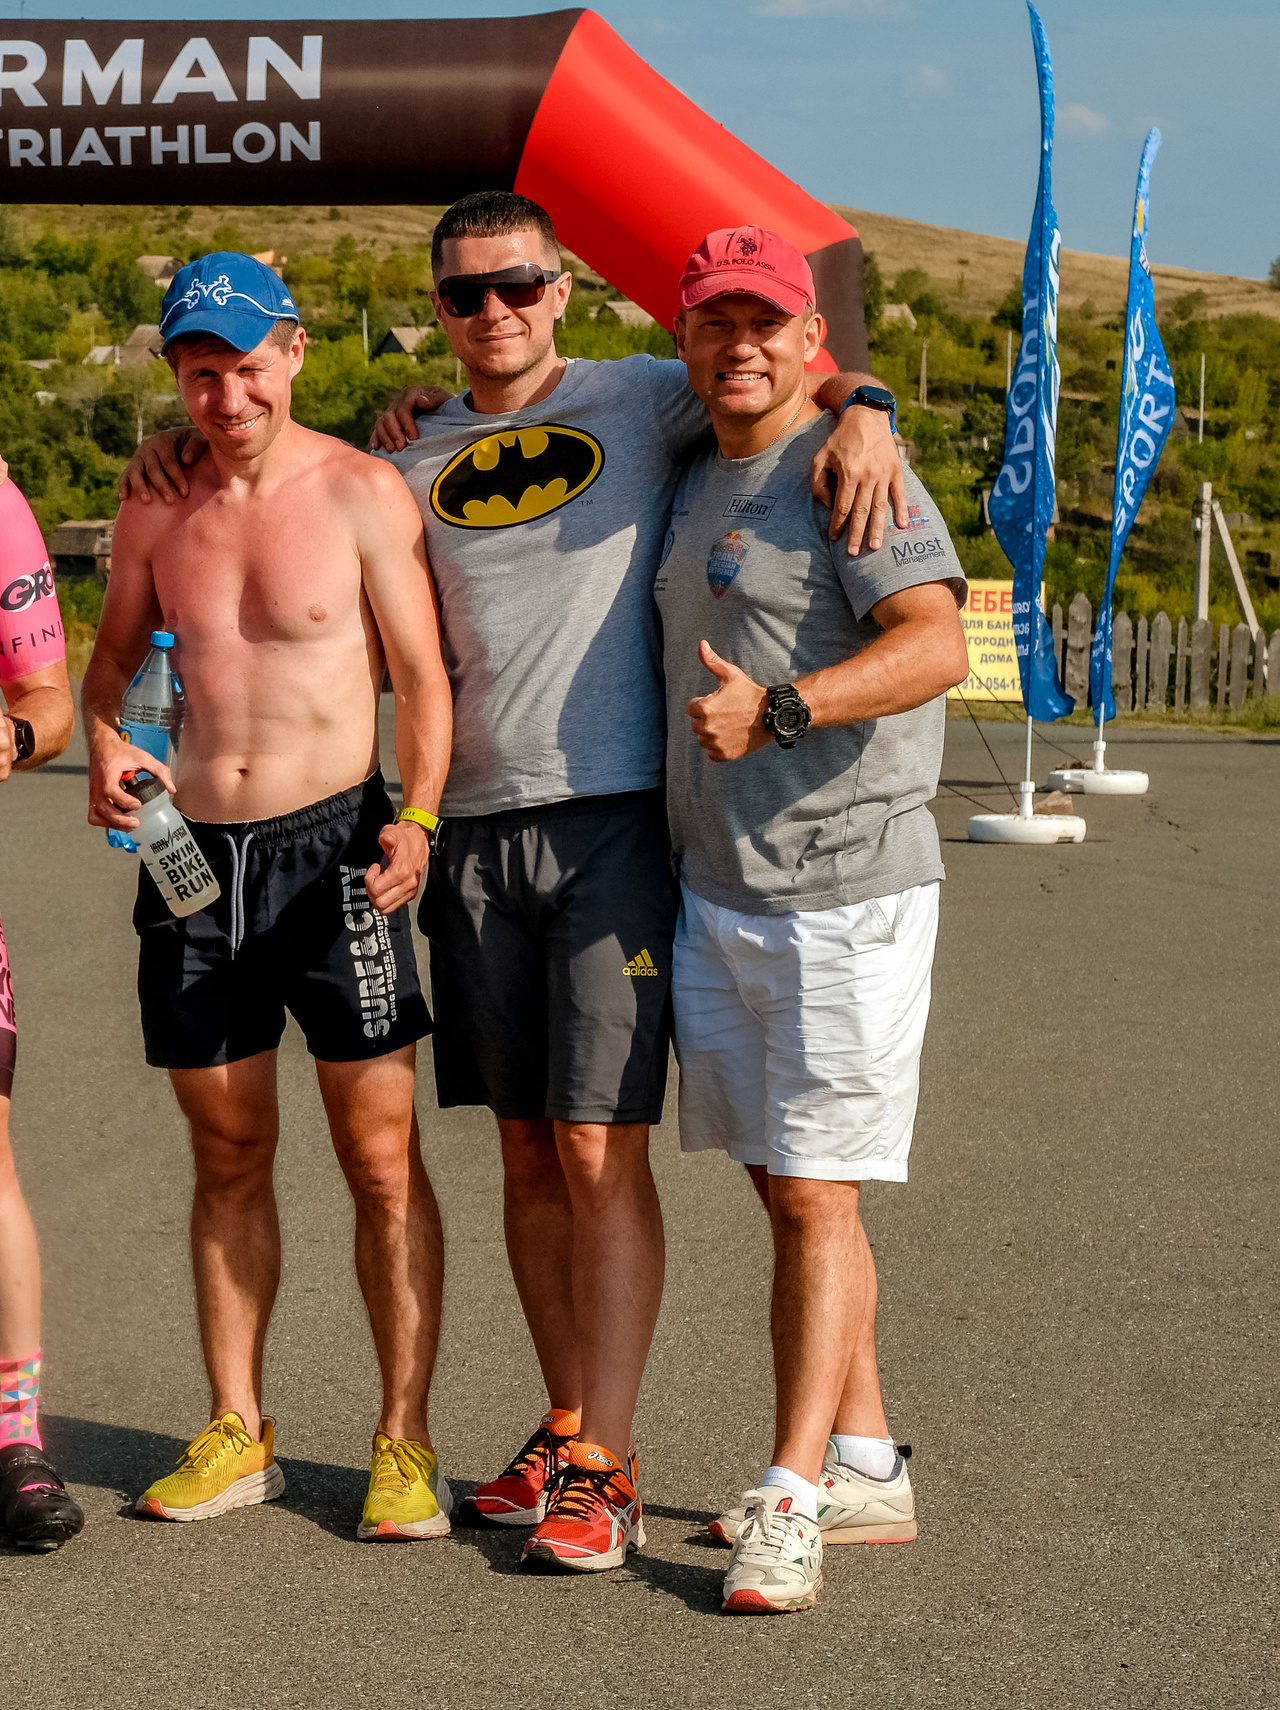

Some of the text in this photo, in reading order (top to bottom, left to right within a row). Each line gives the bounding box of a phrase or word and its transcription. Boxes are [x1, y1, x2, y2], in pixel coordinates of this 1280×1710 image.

[731, 258, 754, 266] POLO
[755, 260, 777, 273] ASSN.
[1115, 353, 1175, 536] SPORT
[728, 499, 768, 516] Hilton
[891, 537, 944, 560] Most
[895, 550, 946, 567] Management
[980, 653, 1013, 665] ДОМА
[159, 840, 197, 870] SWIM
[166, 852, 205, 885] BIKE
[174, 868, 214, 902] RUN
[339, 865, 374, 932] CITY
[622, 966, 658, 976] adidas
[353, 960, 391, 1038] SURF
[389, 993, 397, 1021] LONG
